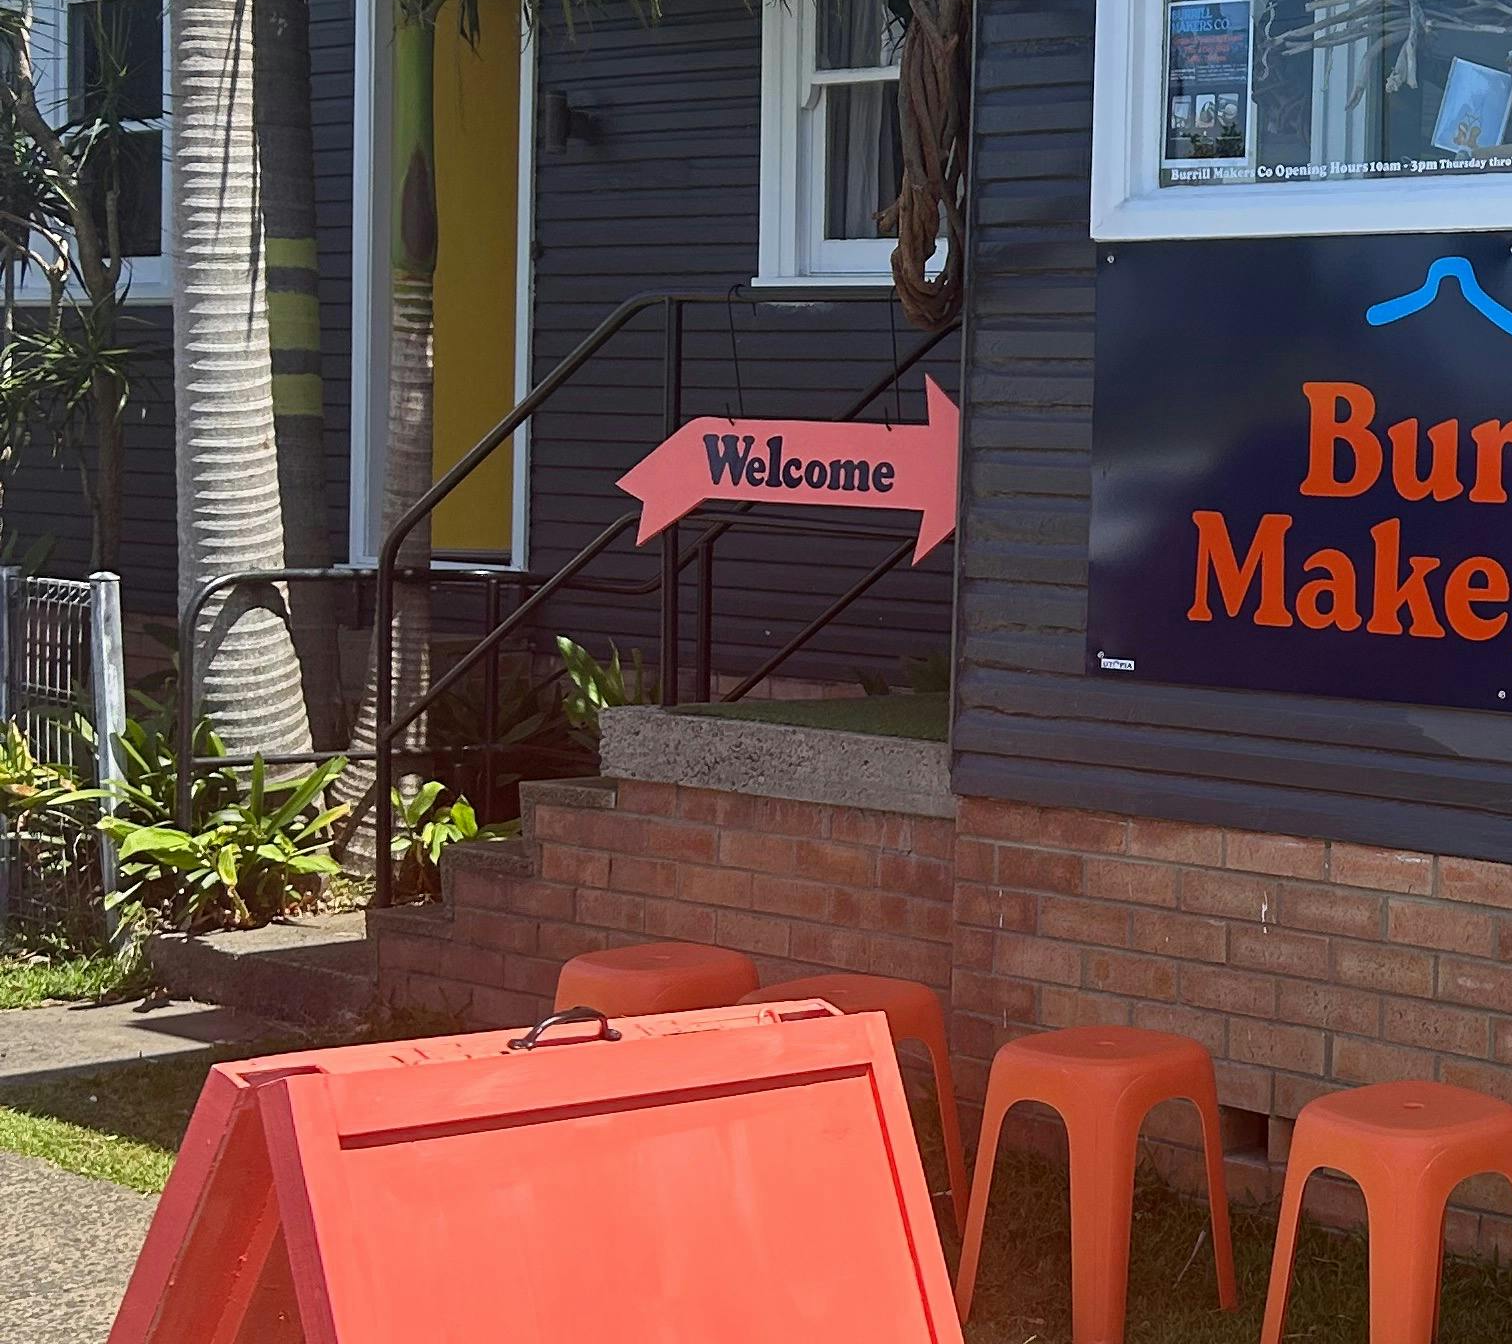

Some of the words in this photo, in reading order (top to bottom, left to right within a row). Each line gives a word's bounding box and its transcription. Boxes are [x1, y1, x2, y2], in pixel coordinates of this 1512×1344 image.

[1170, 167, 1211, 181] Burrill
[1213, 166, 1256, 180] Makers
[1257, 164, 1273, 178] Co
[1275, 162, 1328, 178] Opening
[1329, 161, 1369, 174] Hours
[1370, 160, 1401, 173] 10am
[1410, 160, 1438, 174] 3pm
[1439, 157, 1487, 171] Thursday
[703, 433, 896, 493] Welcome
[1103, 660, 1132, 669] UTOPIA
